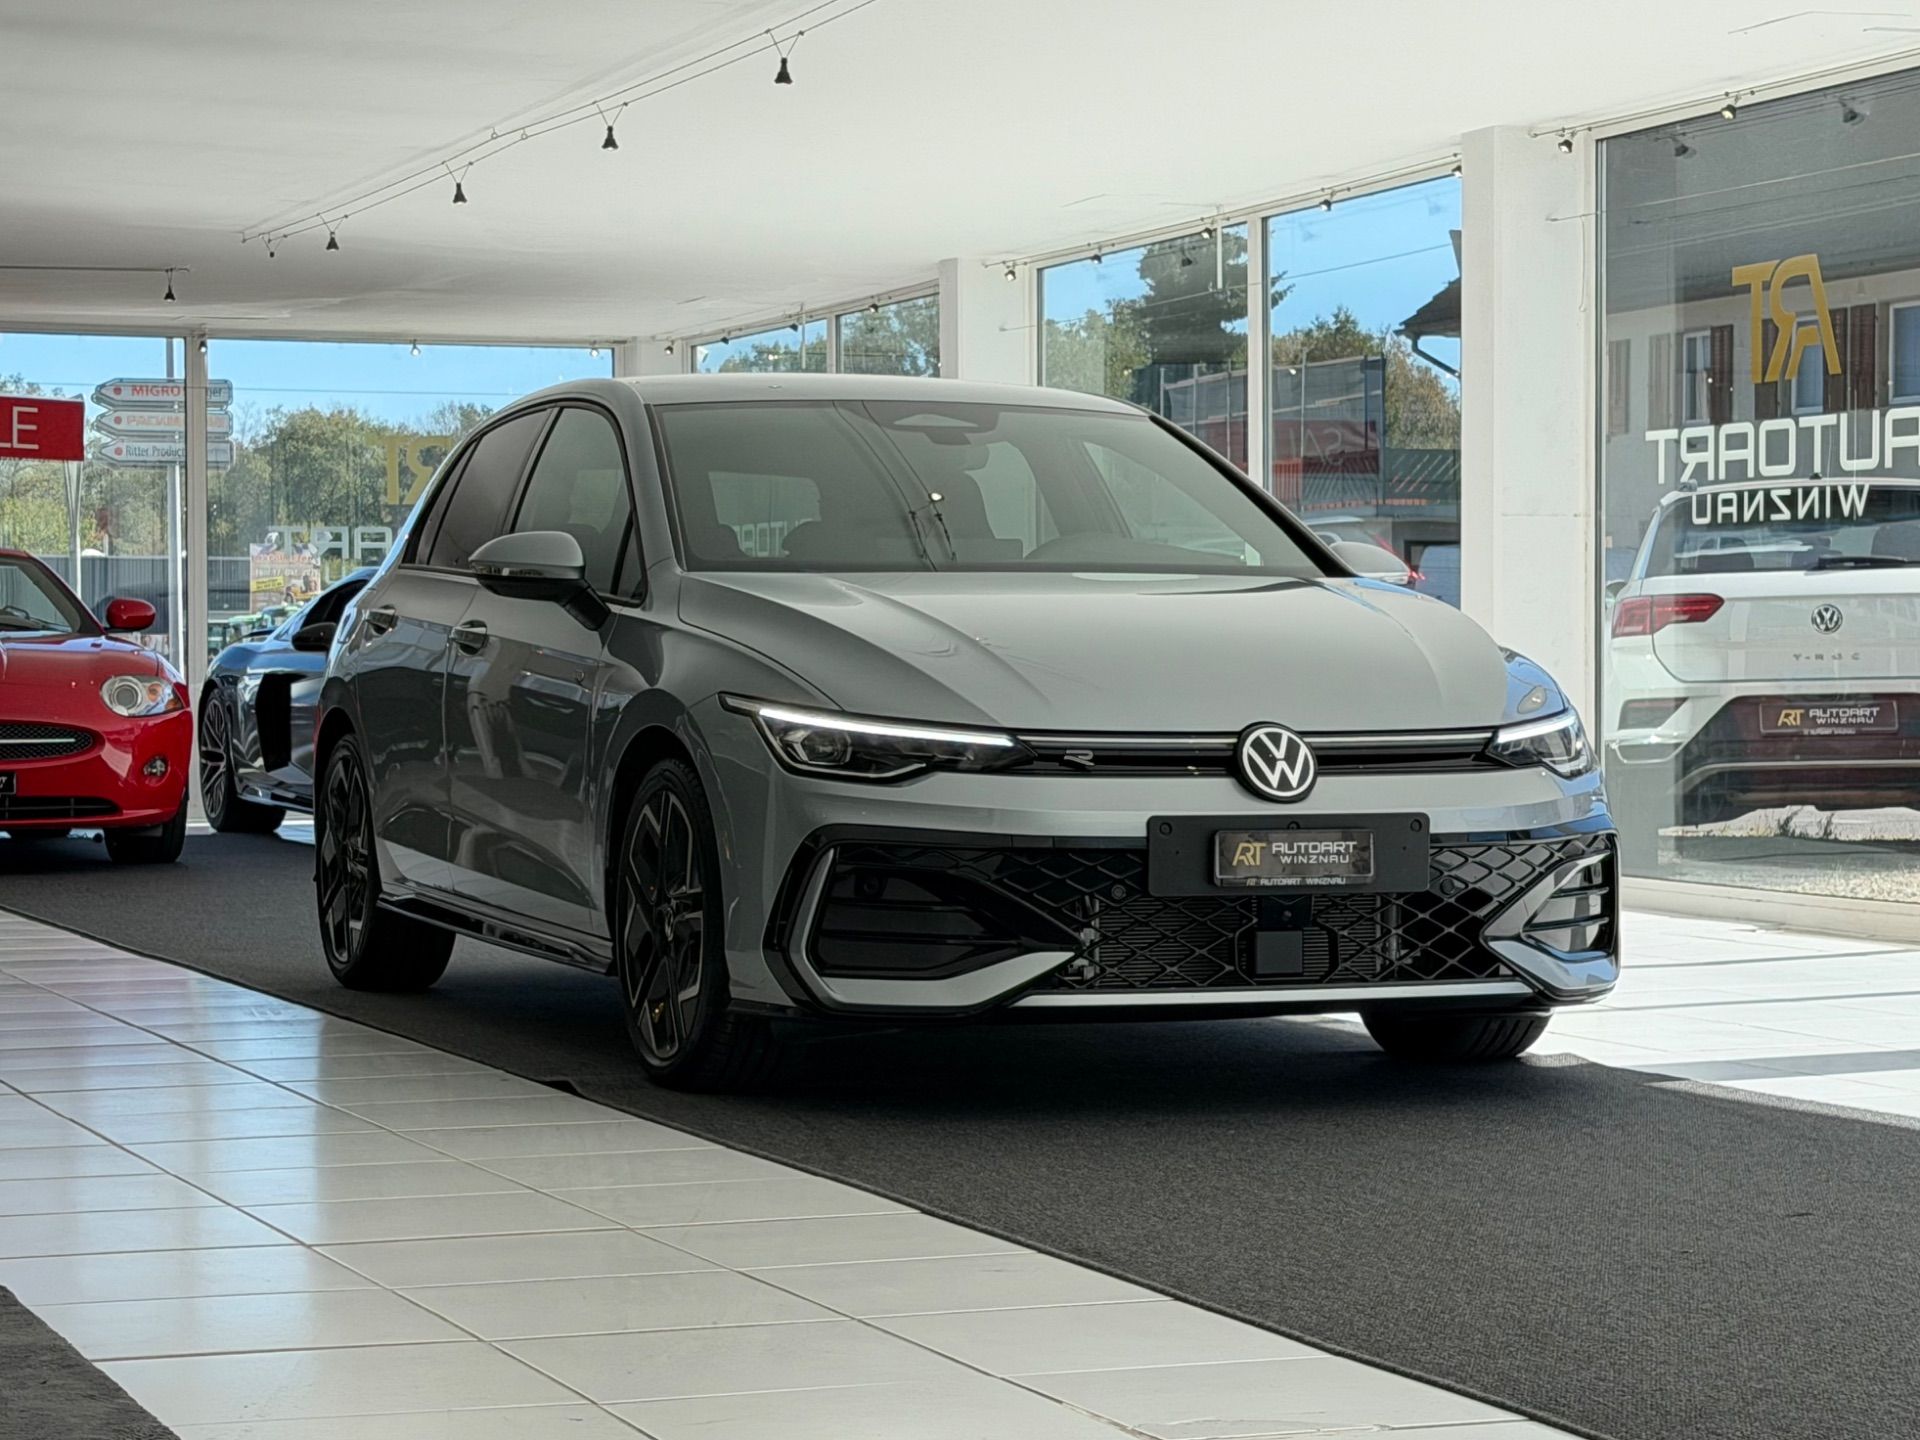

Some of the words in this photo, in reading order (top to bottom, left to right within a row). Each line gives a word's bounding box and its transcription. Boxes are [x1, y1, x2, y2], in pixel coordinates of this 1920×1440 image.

[131, 384, 181, 397] MIGRO
[1809, 707, 1880, 718] AUTOART
[1271, 841, 1358, 855] AUTOART
[1279, 854, 1350, 865] WINZNAU
[1260, 878, 1302, 886] AUTOART
[1306, 877, 1346, 886] WINZNAU
